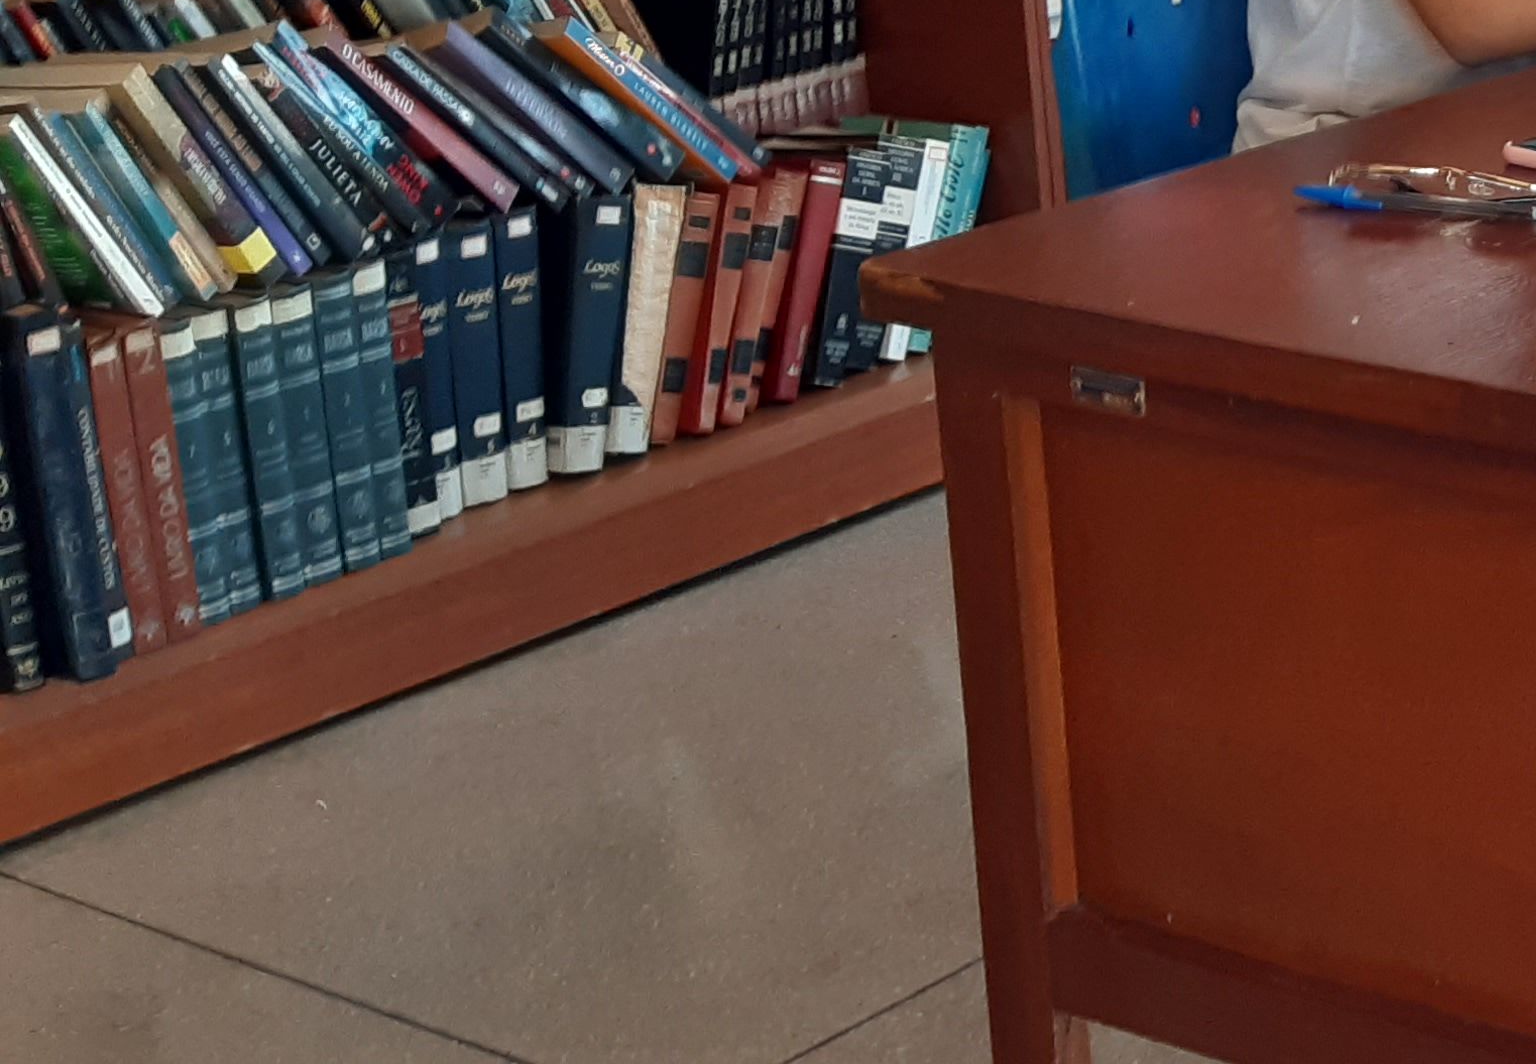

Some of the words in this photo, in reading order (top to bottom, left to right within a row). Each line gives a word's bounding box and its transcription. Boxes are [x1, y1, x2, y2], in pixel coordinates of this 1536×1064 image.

[339, 43, 356, 60] O
[348, 51, 417, 115] CASAMENTO
[308, 138, 366, 208] JULIETA
[583, 259, 621, 278] Logos
